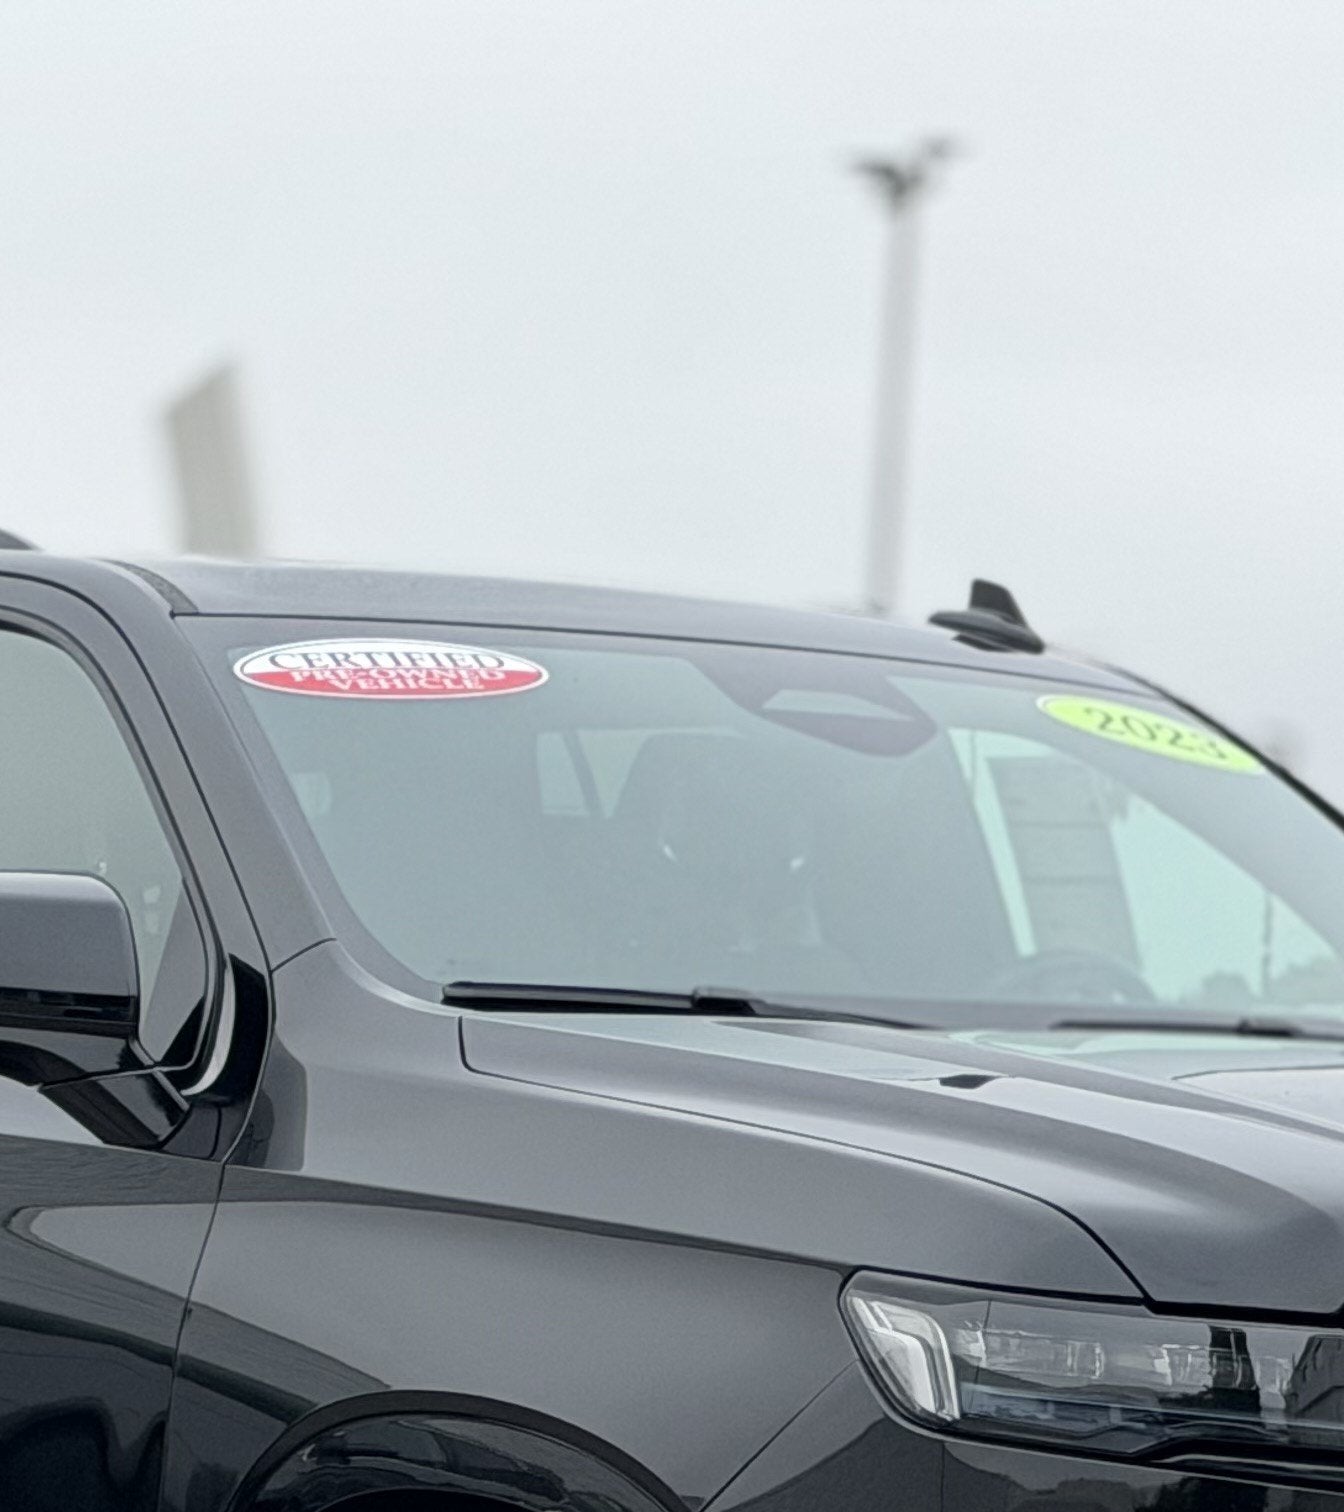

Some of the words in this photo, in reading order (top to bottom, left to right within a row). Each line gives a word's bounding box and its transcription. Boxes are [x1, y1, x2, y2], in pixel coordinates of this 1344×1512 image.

[267, 651, 505, 671] CERTIFIED
[288, 667, 508, 683] PRE-OWNED
[326, 678, 484, 691] VEHICLE
[1082, 705, 1231, 761] 2023
